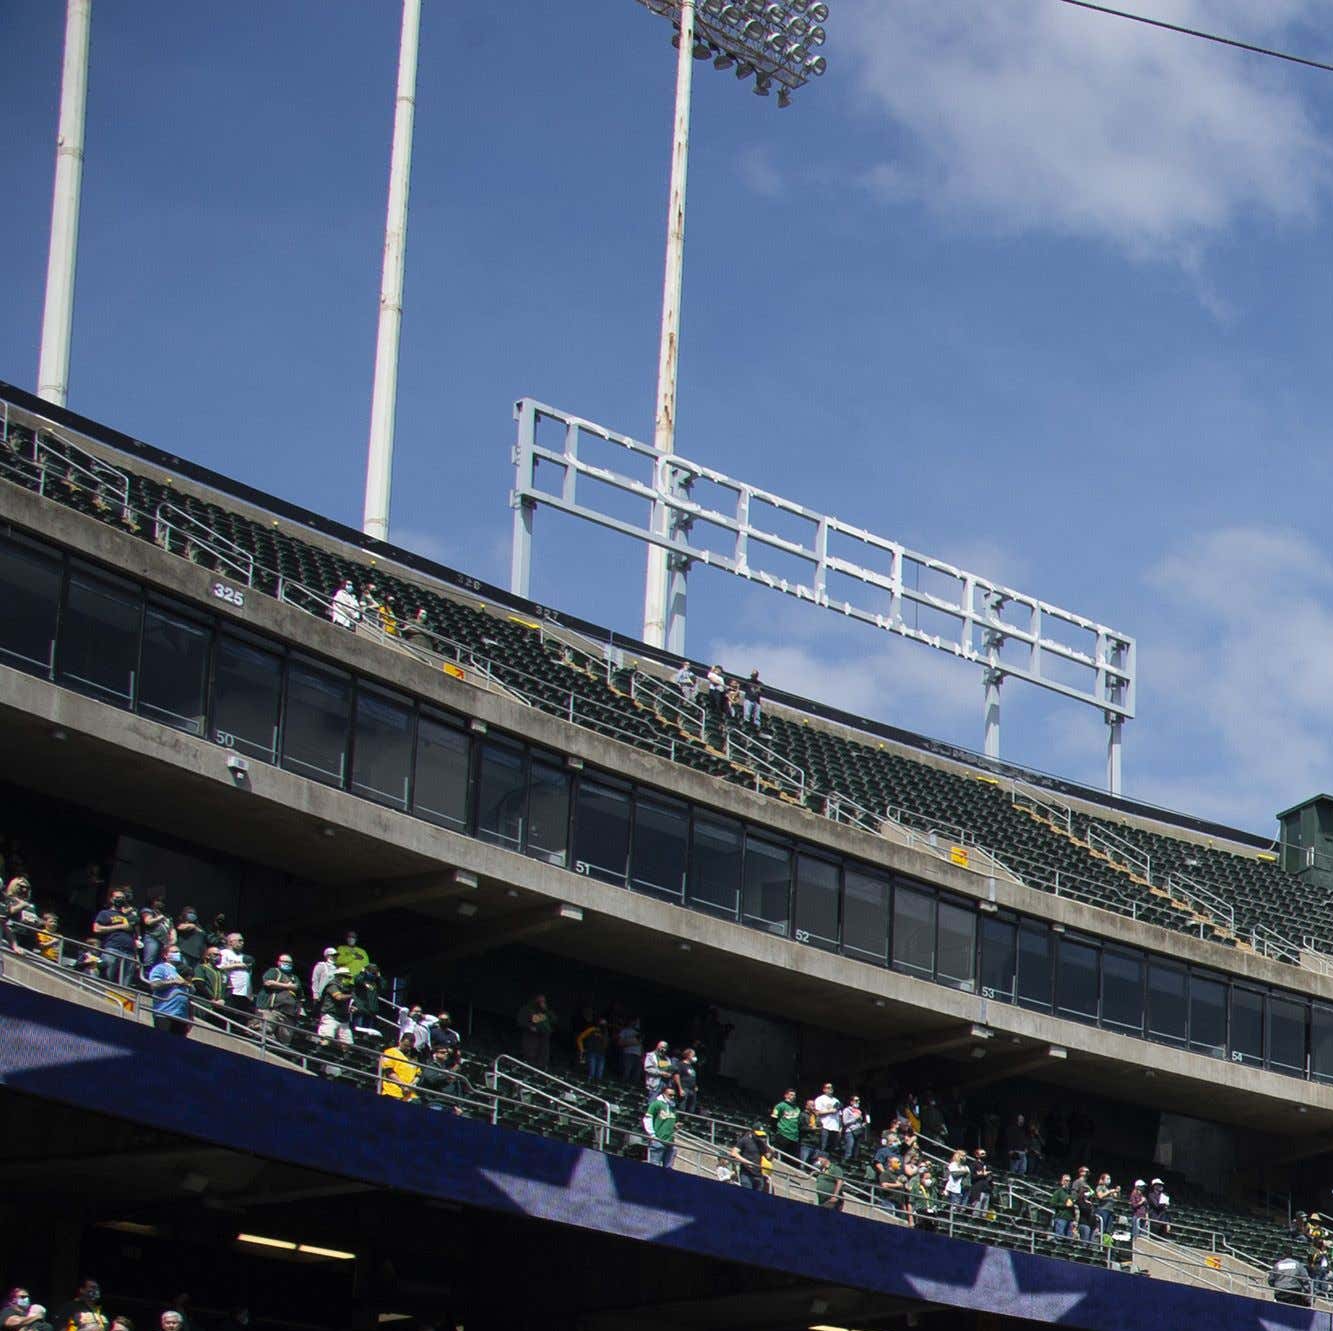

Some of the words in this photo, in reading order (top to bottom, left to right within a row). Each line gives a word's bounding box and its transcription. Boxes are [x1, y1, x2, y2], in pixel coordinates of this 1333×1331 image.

[214, 583, 244, 606] 325
[216, 731, 234, 747] 50
[576, 860, 590, 875] 51
[796, 929, 810, 943] 52
[982, 987, 995, 998] 53
[1232, 1051, 1243, 1062] 54
